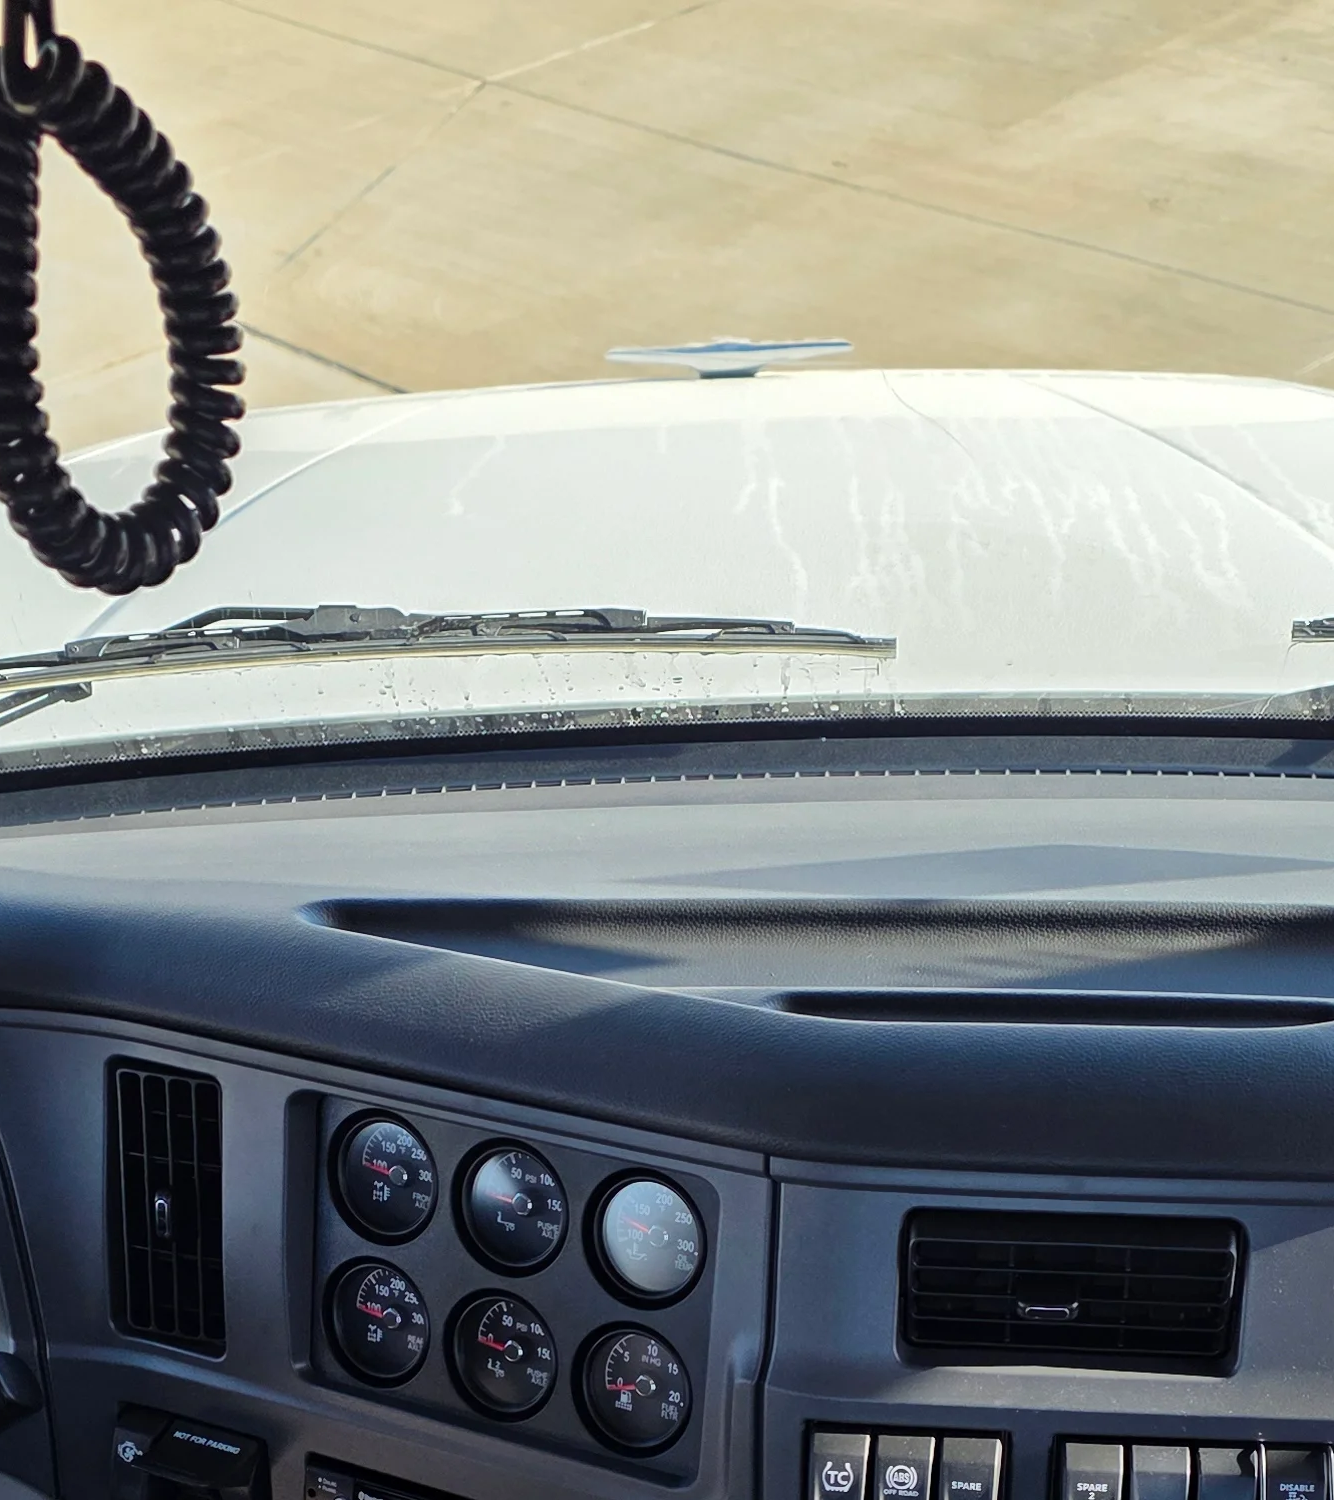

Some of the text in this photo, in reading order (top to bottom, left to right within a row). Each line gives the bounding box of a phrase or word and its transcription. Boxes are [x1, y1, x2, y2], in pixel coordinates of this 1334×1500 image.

[381, 1140, 397, 1155] 150
[397, 1134, 414, 1148] 200
[510, 1167, 523, 1179] 50
[525, 1174, 537, 1184] PSI
[656, 1192, 674, 1206] 200
[635, 1204, 651, 1216] 150
[674, 1211, 693, 1225] 250
[628, 1229, 644, 1241] 100
[677, 1239, 695, 1253] 300
[375, 1284, 390, 1297] 150
[390, 1278, 406, 1291] 200
[502, 1314, 513, 1327] 50
[516, 1322, 528, 1332] PSI
[623, 1351, 630, 1362] 5
[647, 1344, 658, 1357] 10
[667, 1362, 679, 1375] 15
[668, 1390, 681, 1404] 20
[173, 1430, 242, 1455] NOT FOR PARKING
[827, 1470, 849, 1486] TC
[892, 1472, 910, 1484] ABS
[951, 1480, 982, 1492] SPARE
[1076, 1482, 1108, 1493] SPARE
[1279, 1482, 1316, 1493] DISABLE
[883, 1488, 919, 1498] OFF ROAD
[1088, 1492, 1095, 1500] 2
